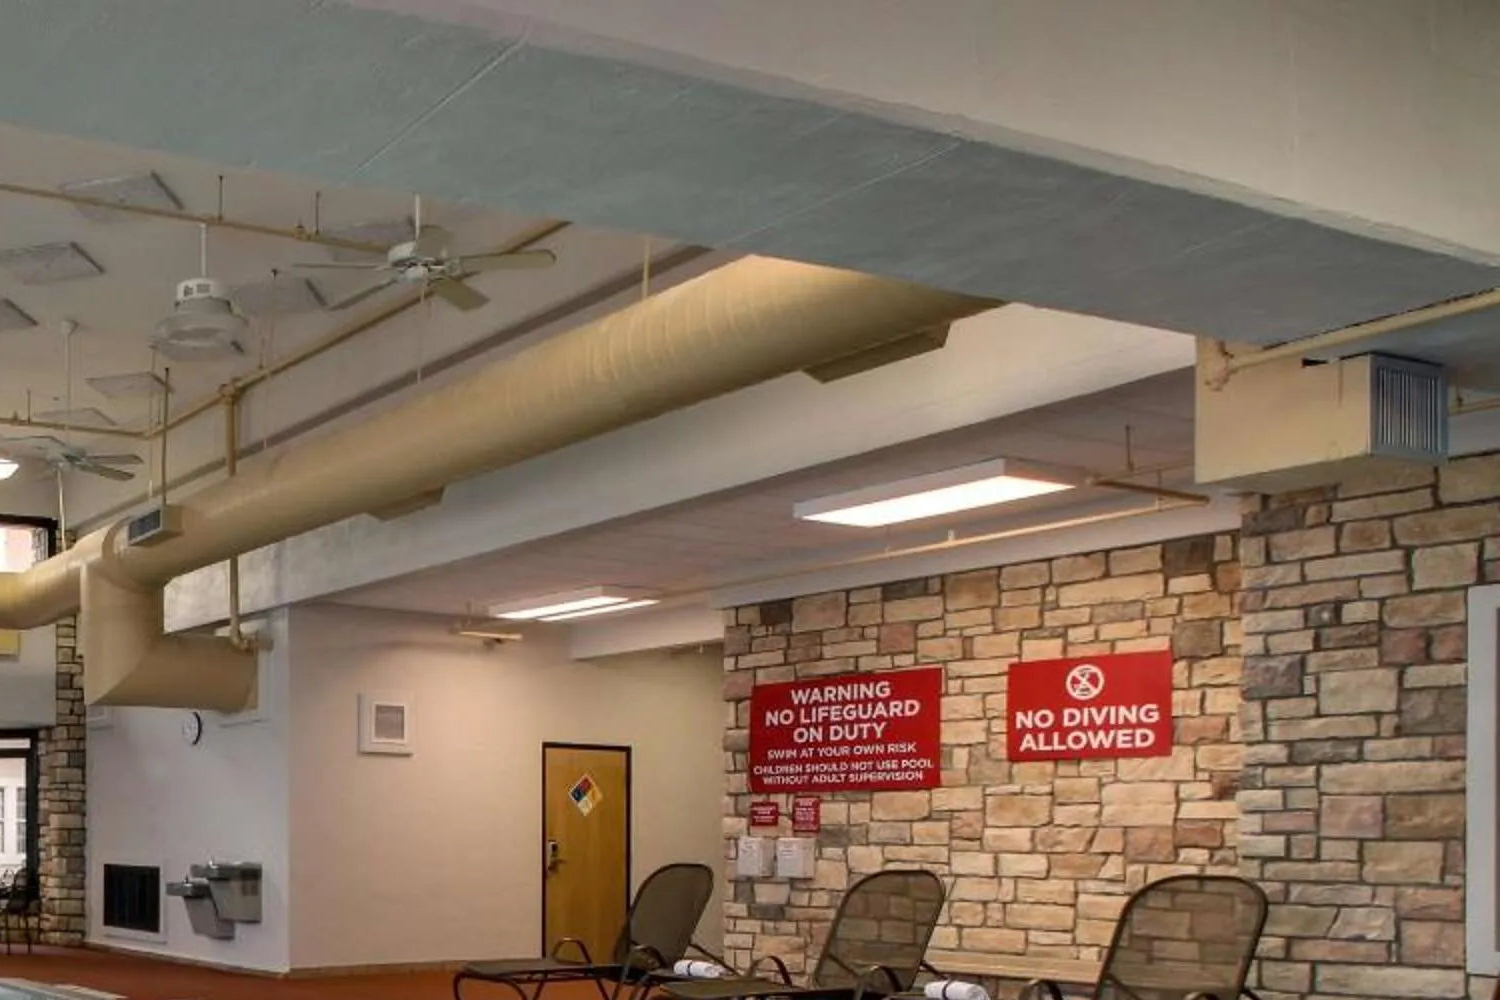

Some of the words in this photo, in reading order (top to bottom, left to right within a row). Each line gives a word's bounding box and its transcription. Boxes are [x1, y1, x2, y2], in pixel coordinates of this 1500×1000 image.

[791, 681, 891, 705] WARNING
[765, 709, 794, 727] NO
[800, 699, 921, 724] LIFEGUARD
[1015, 708, 1055, 729] NO
[1062, 703, 1160, 727] DIVING
[793, 727, 823, 743] ON
[829, 721, 888, 742] DUTY
[1019, 728, 1155, 752] ALLOWED
[767, 749, 797, 760] SWIM
[799, 747, 815, 758] AT
[817, 745, 850, 757] YOUR
[853, 743, 885, 755] OWN
[887, 742, 917, 754] RISK
[753, 763, 803, 775] CHILDREN
[805, 761, 848, 773] SHOULD
[851, 760, 874, 771] NOT
[876, 759, 899, 770] USE
[901, 758, 935, 769] POOL
[762, 774, 808, 785] WITHOUT
[811, 773, 847, 784] ADULT
[849, 770, 923, 783] SUPERVISION
